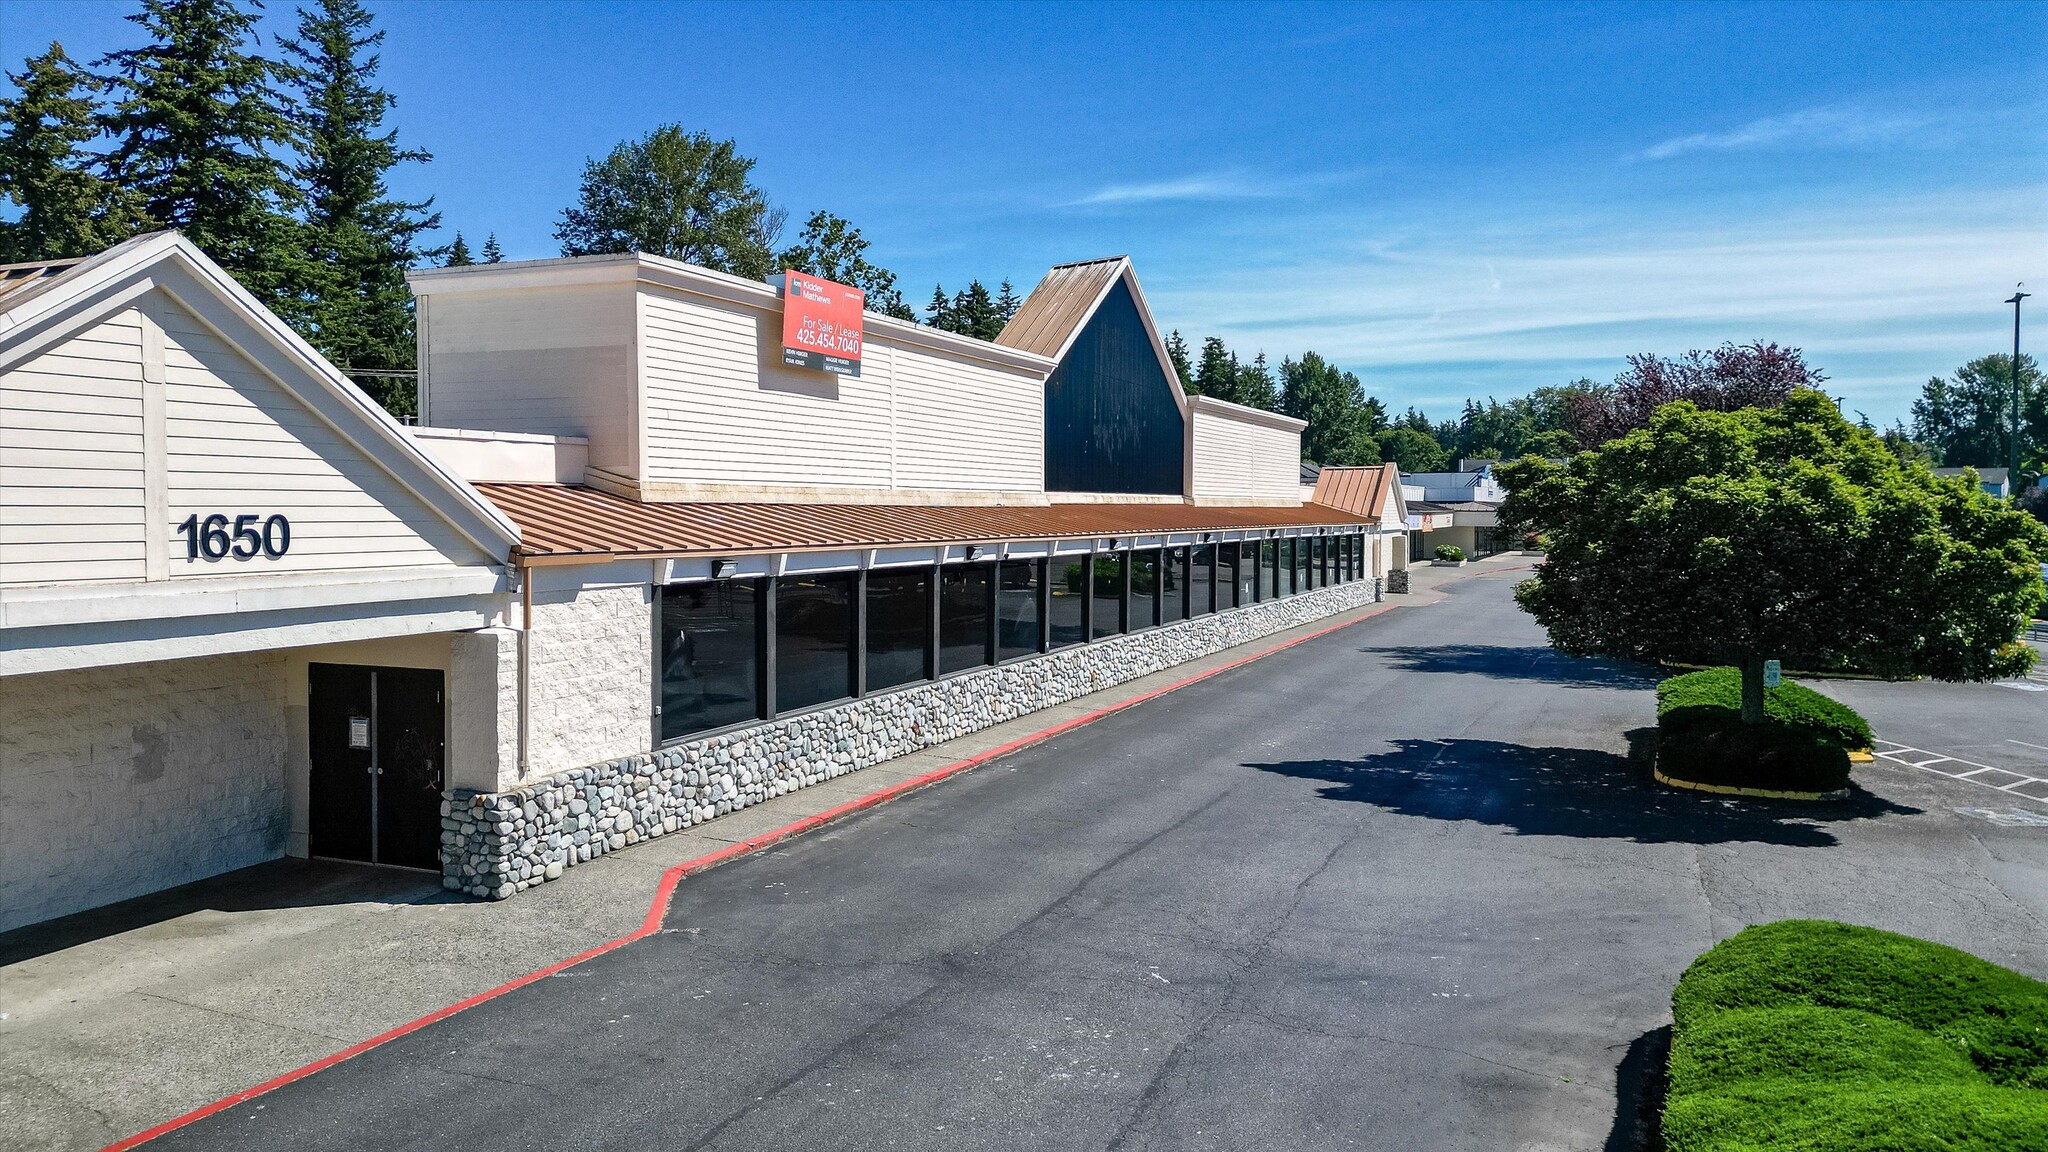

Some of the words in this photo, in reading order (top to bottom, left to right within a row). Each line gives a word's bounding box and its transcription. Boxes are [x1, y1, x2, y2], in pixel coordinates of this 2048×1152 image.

[803, 280, 823, 293] Kidder
[803, 290, 831, 305] Mathews
[803, 315, 816, 329] For
[817, 318, 833, 334] Sale
[839, 325, 859, 340] Lease
[796, 328, 859, 354] 425.454.7040
[177, 513, 291, 563] 1650
